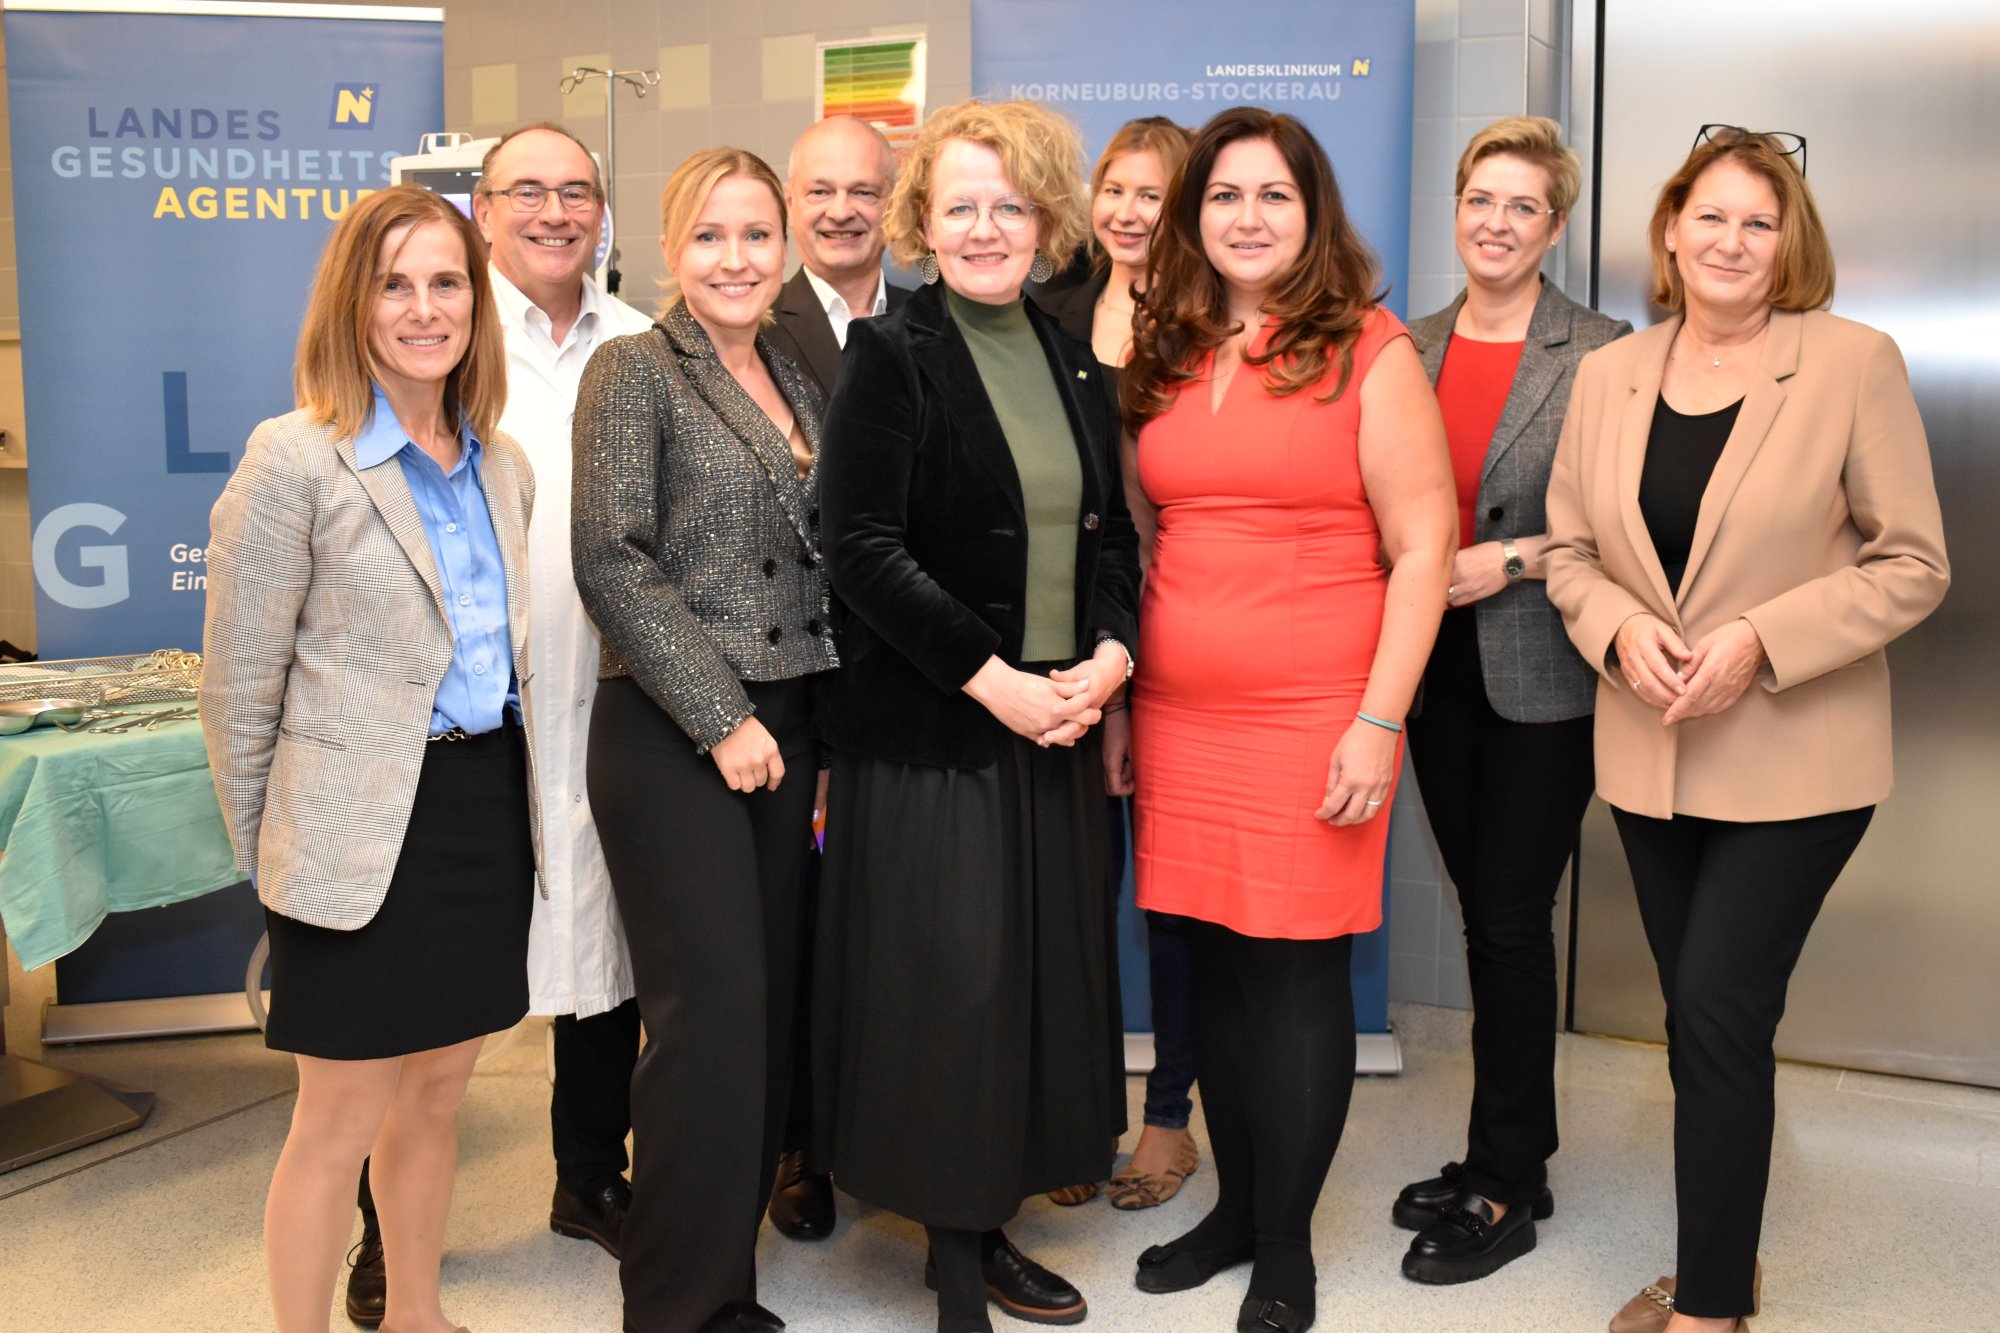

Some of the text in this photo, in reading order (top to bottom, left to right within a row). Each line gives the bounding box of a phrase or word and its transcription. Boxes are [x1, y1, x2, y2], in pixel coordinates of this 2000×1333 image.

[1206, 65, 1340, 76] LANDESKLINIKUM
[335, 90, 371, 123] N
[1010, 82, 1341, 100] KORNEUBURG-STOCKERAU
[88, 107, 281, 141] LANDES
[153, 186, 377, 221] AGENTU
[163, 371, 231, 474] L
[32, 503, 130, 609] G
